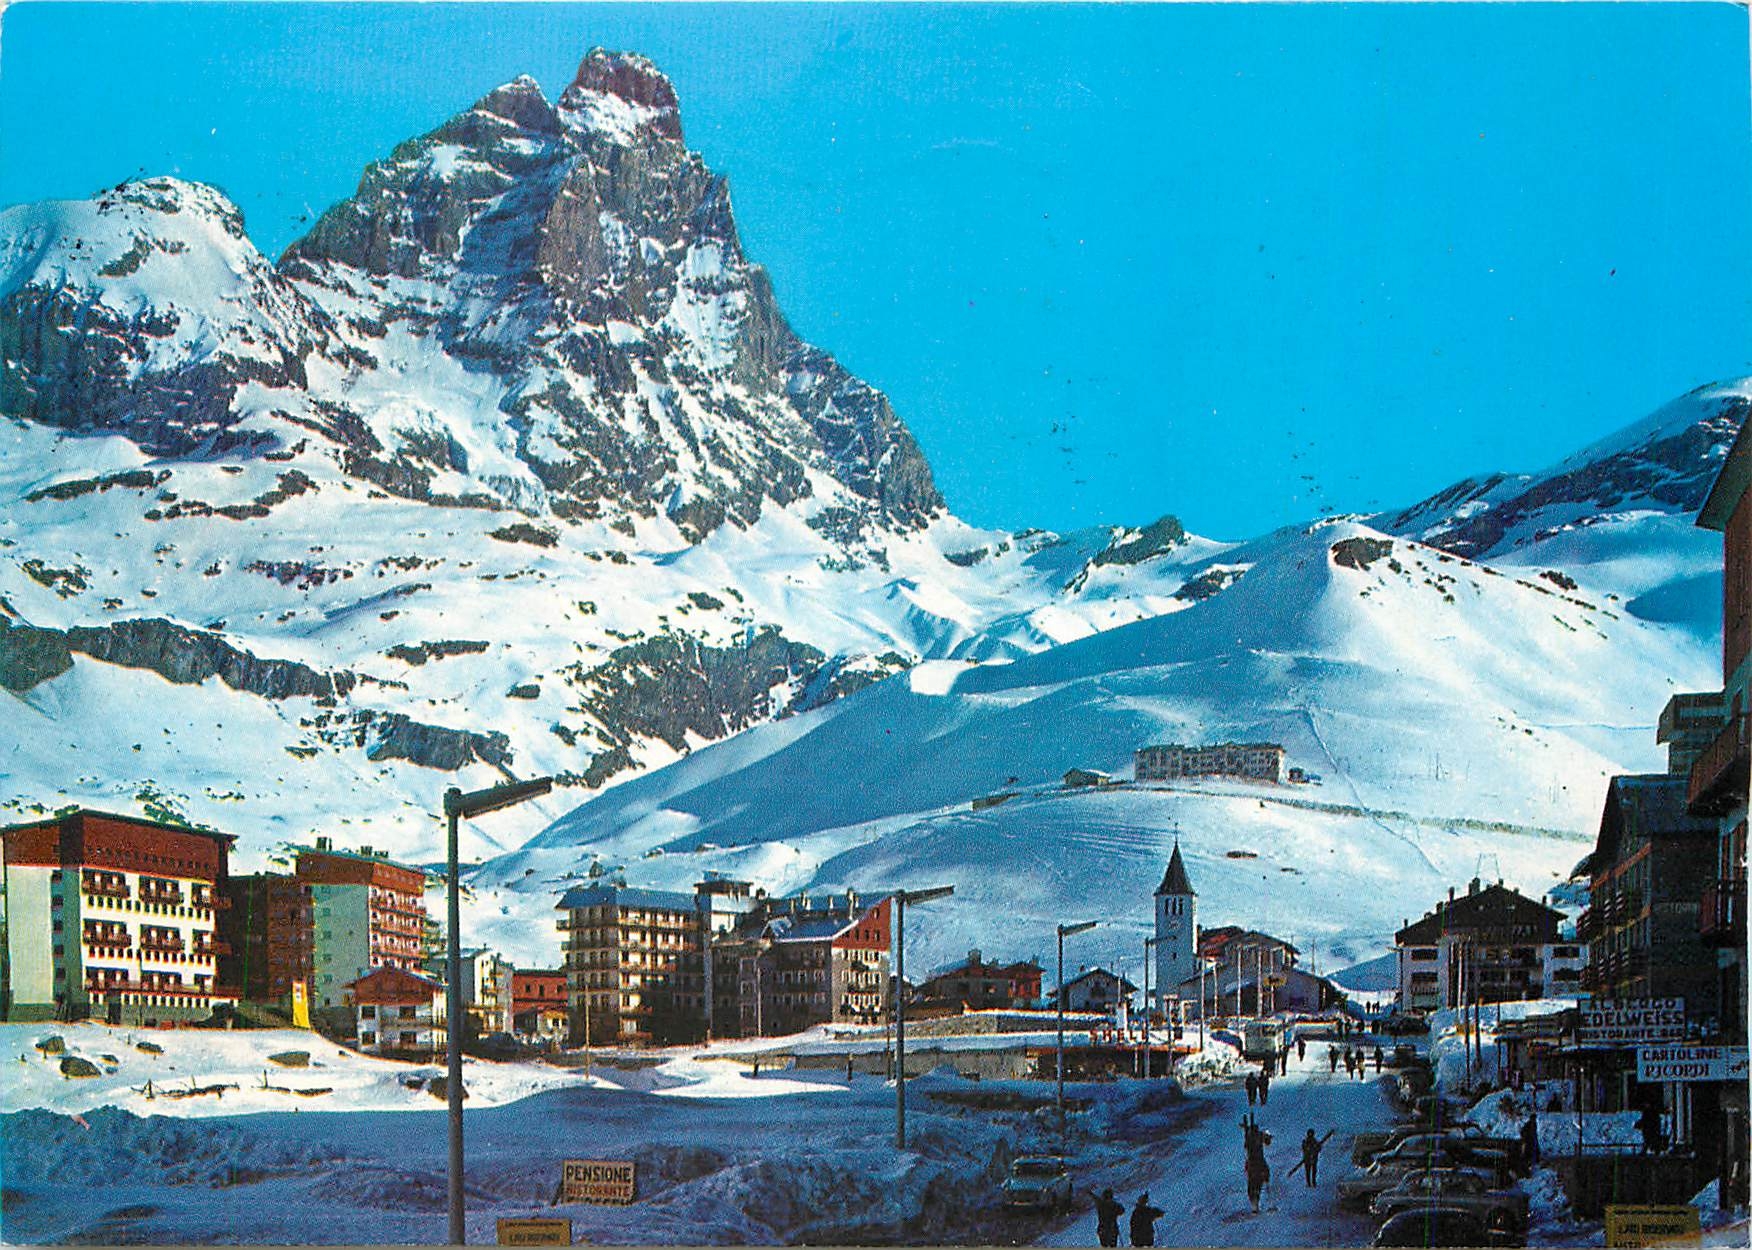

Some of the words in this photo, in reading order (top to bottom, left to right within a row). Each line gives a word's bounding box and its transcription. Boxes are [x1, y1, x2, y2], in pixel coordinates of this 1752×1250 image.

[1583, 1011, 1685, 1026] EDELWEISS
[1089, 1028, 1147, 1041] SHELL
[1643, 1049, 1721, 1061] CARTOLINE
[566, 1165, 631, 1184] PENSIONE
